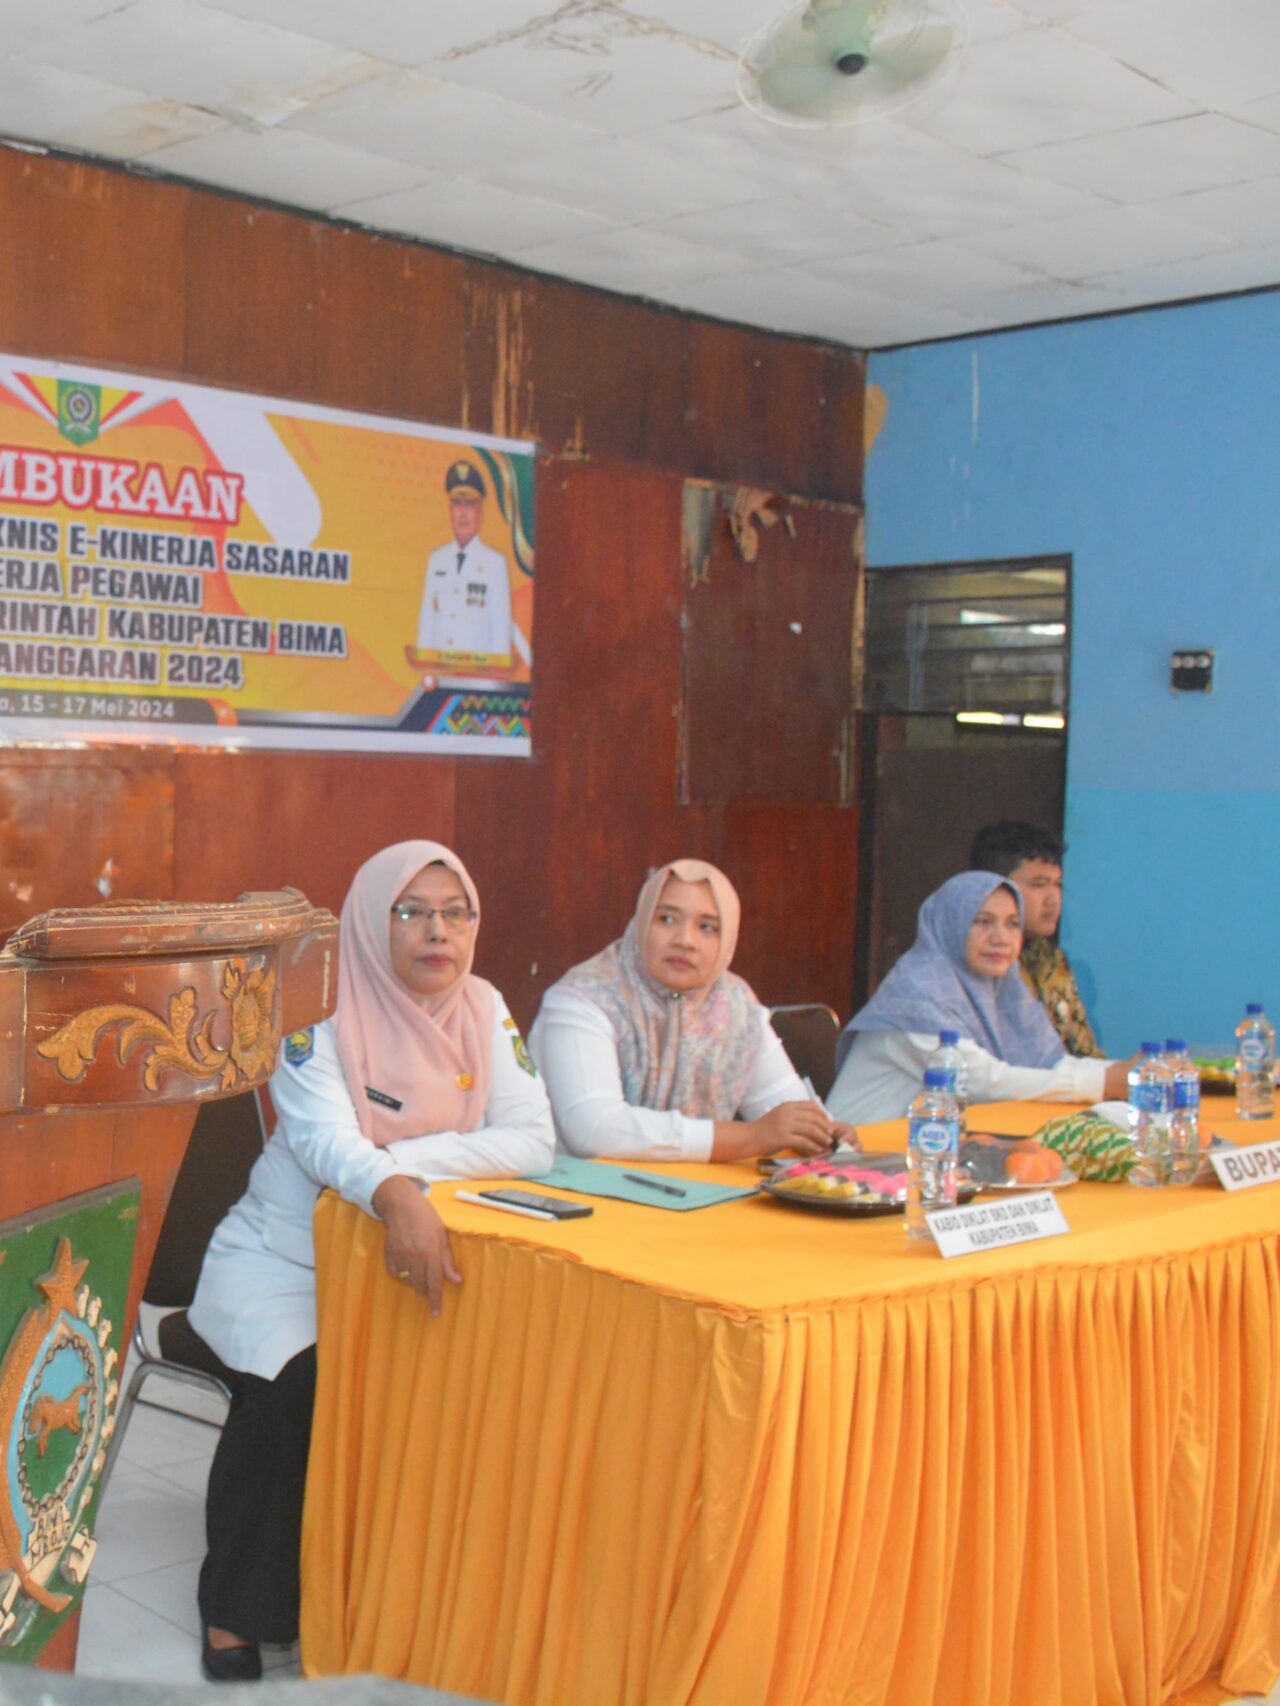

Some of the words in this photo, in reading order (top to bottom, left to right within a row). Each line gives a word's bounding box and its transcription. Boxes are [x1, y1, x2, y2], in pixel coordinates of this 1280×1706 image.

[70, 524, 217, 569] E-KINERJA
[225, 542, 349, 581] SASARAN
[70, 564, 202, 606] PEGAWAI
[107, 607, 268, 650] KABUPATEN
[278, 622, 345, 654] BIMA
[166, 652, 242, 686] 2024
[21, 694, 45, 713] 15
[63, 697, 86, 714] 17
[91, 698, 122, 716] Mei
[127, 699, 176, 718] 2024
[1223, 1146, 1280, 1182] BUPA
